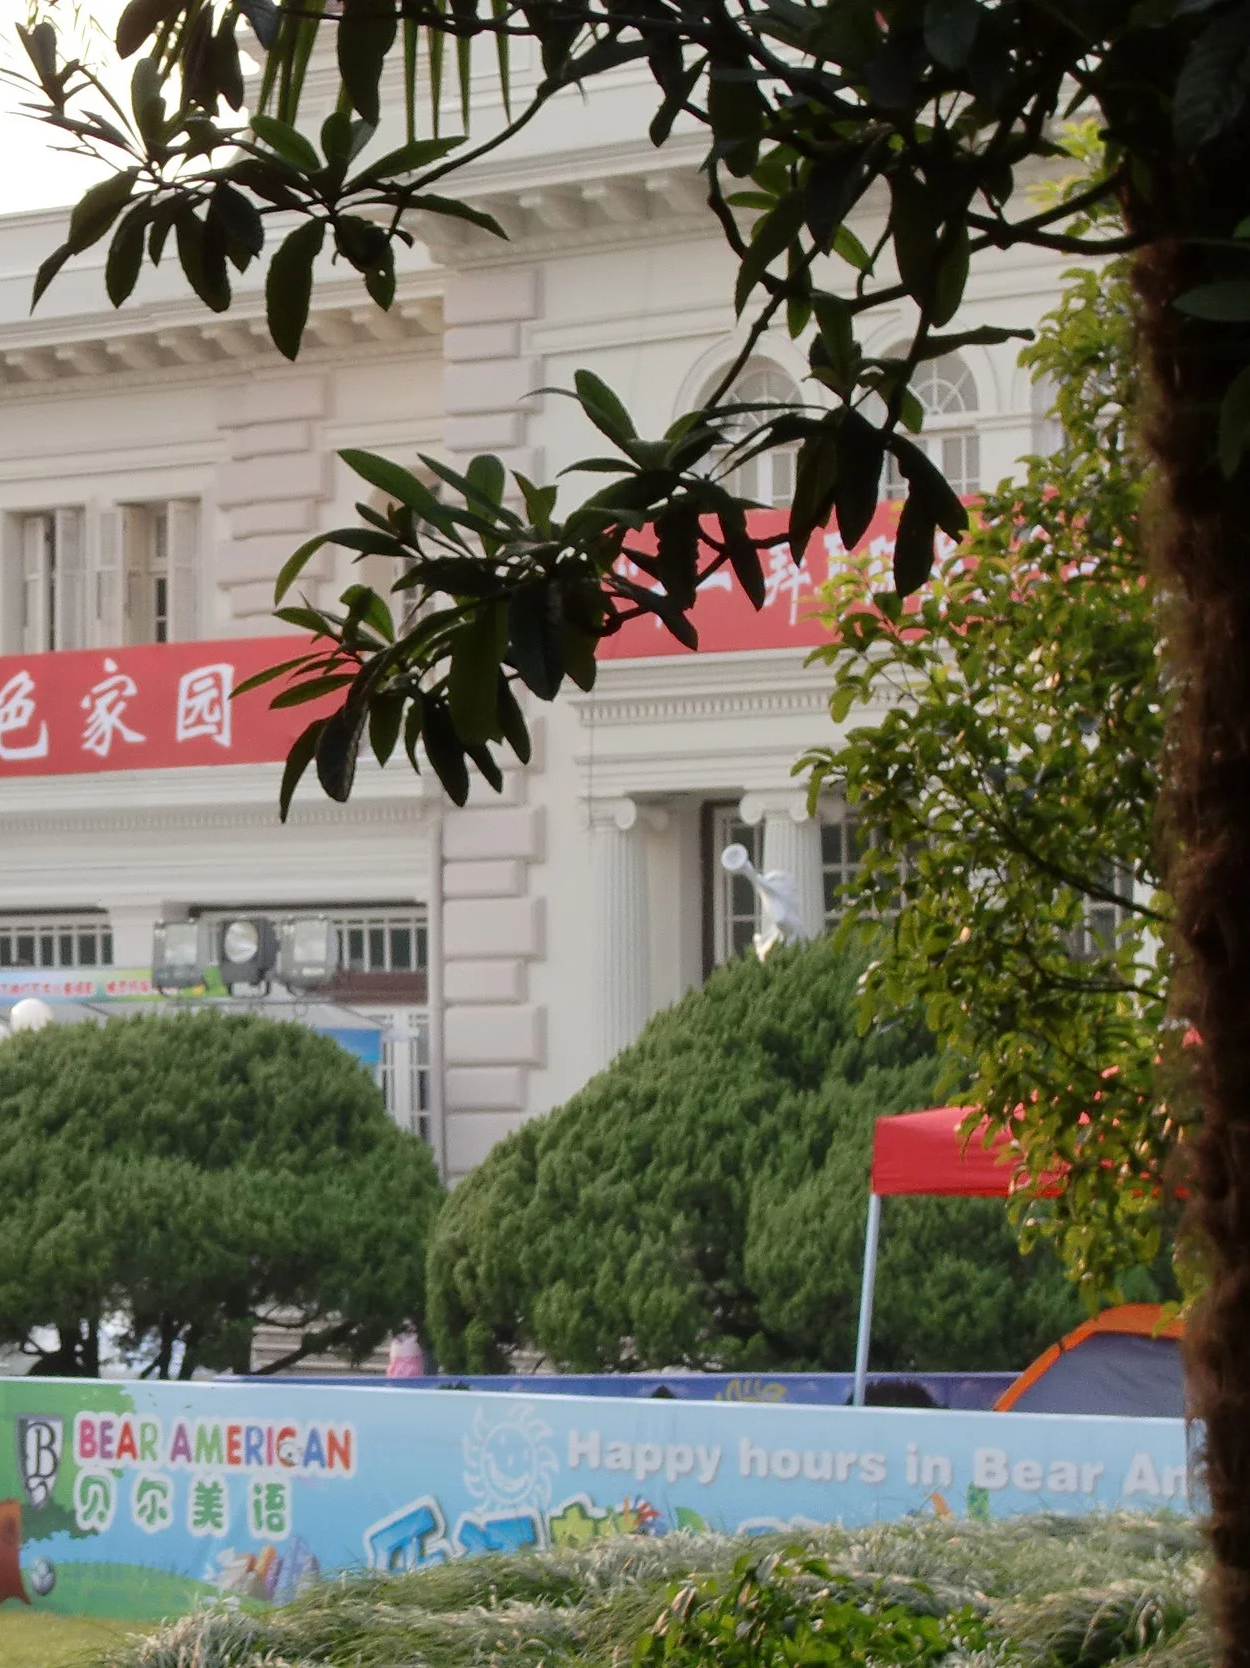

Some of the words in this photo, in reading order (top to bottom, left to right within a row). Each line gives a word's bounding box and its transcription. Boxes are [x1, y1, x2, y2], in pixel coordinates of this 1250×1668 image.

[80, 1419, 158, 1460] BEAR
[170, 1422, 352, 1470] AMERICAN
[568, 1429, 721, 1483] Happy
[740, 1436, 886, 1483] hours
[907, 1444, 952, 1487] in
[973, 1448, 1103, 1492] Bear
[80, 1475, 286, 1534] 贝尔美语
